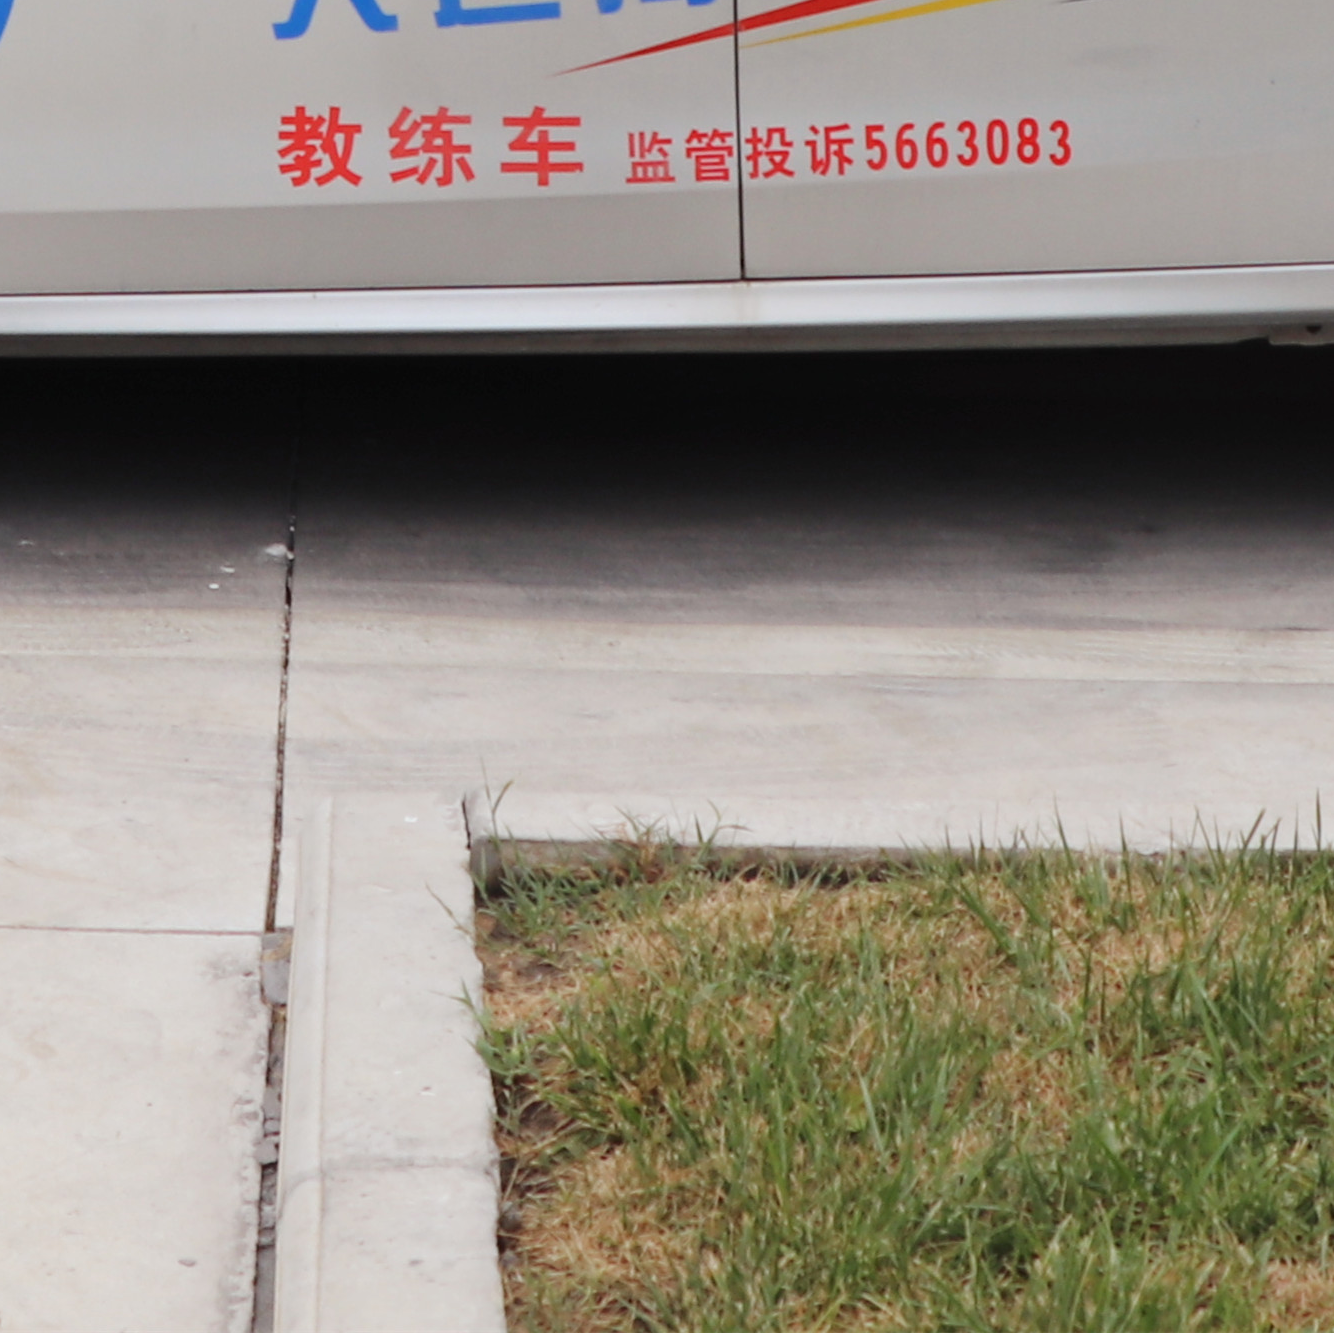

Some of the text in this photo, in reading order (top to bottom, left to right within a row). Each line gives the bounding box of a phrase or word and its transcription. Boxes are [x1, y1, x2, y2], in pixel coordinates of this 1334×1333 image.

[277, 105, 1074, 188] 教练车 监管投诉5663083
